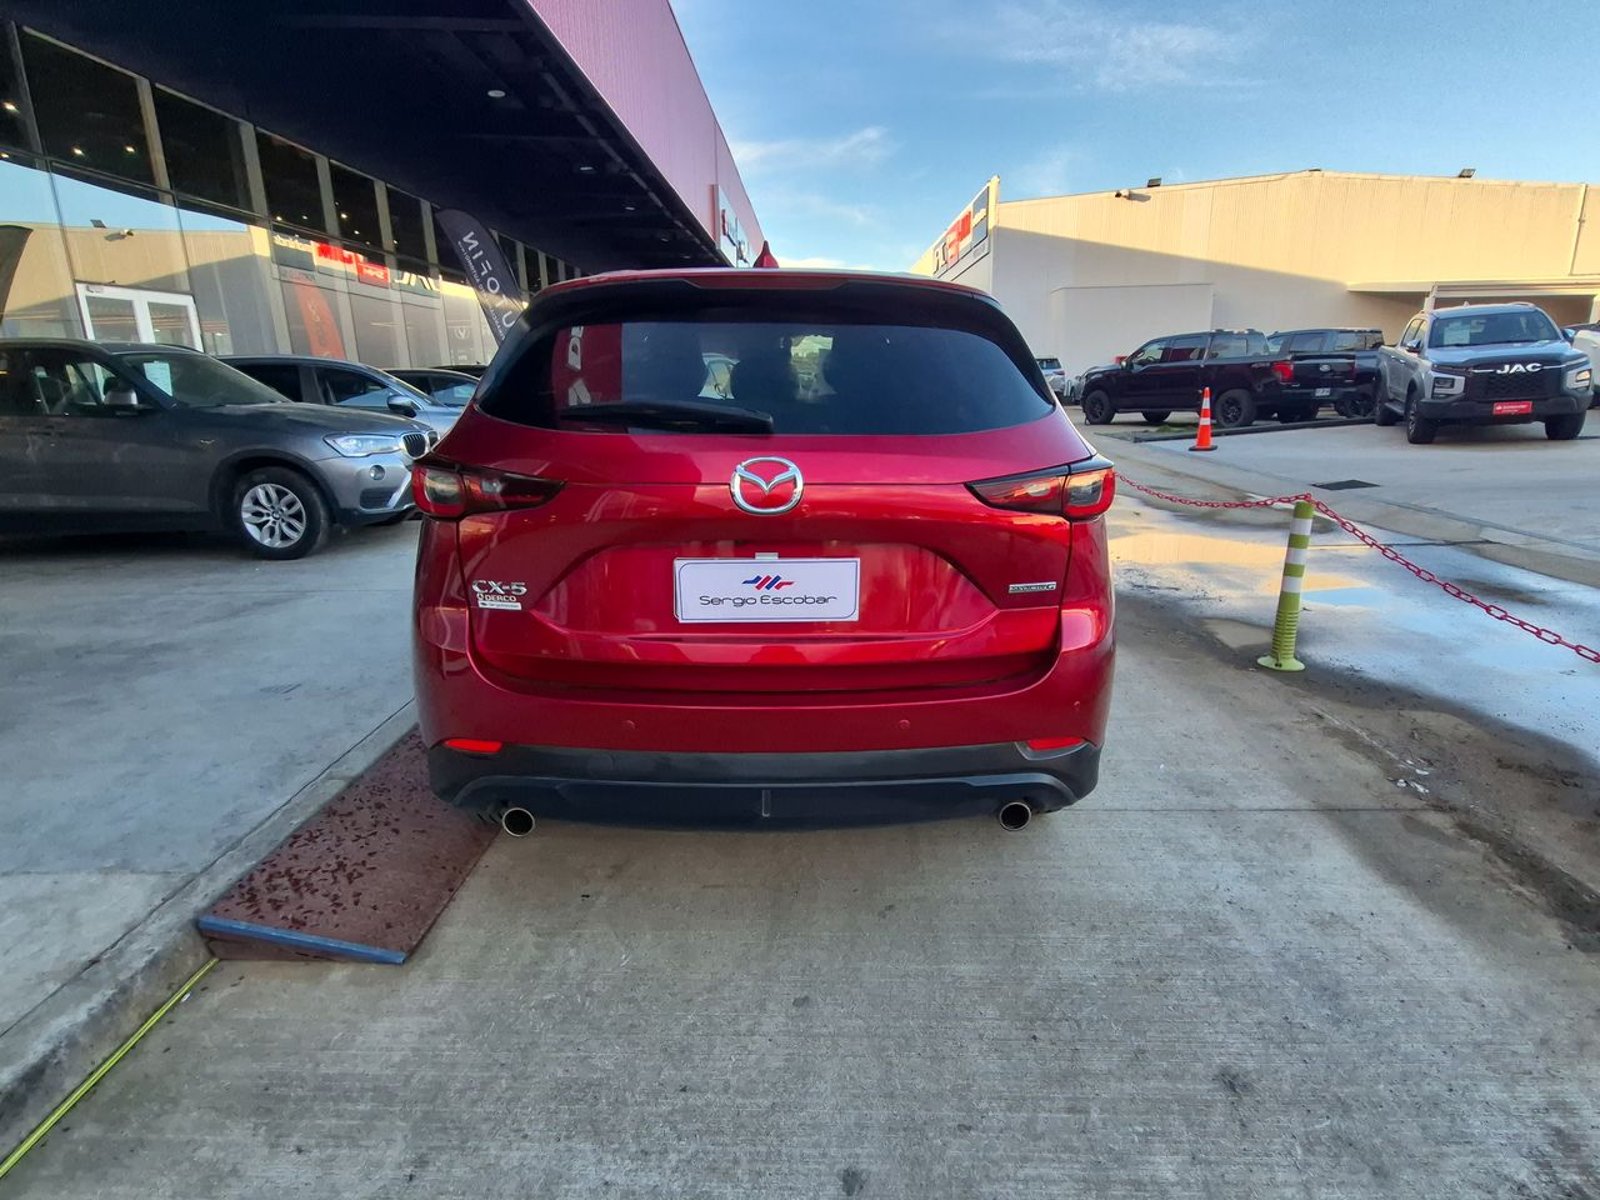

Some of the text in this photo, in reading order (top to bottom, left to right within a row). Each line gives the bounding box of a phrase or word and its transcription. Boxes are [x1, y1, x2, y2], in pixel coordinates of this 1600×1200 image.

[1496, 363, 1542, 374] JAC
[472, 580, 527, 595] CX-5
[760, 595, 838, 605] Escobar
